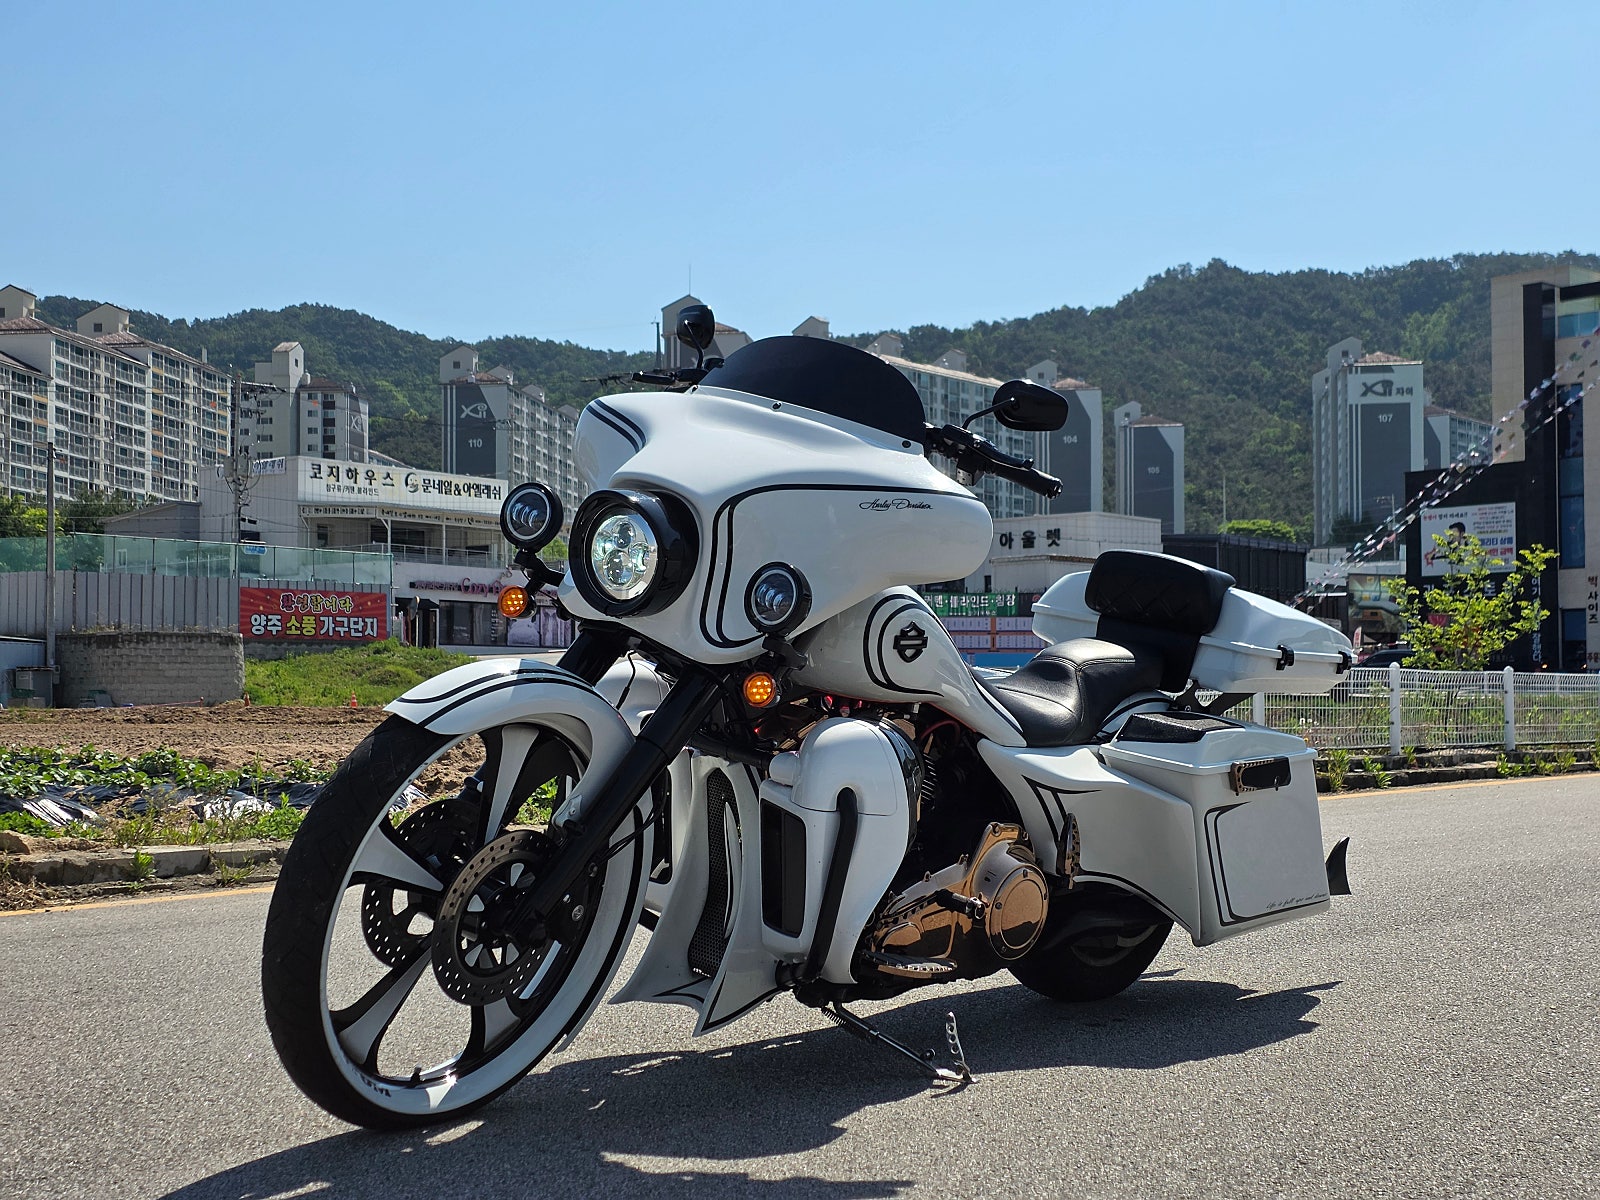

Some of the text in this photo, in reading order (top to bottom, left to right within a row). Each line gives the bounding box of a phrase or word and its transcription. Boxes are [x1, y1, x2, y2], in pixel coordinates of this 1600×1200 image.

[1396, 386, 1413, 396] 자이
[1378, 413, 1393, 423] 107
[468, 438, 483, 448] 110
[1063, 435, 1078, 444] 104
[310, 463, 395, 487] 코지하우스
[1000, 528, 1061, 549] 아울렛
[461, 577, 489, 597] Cozy
[281, 593, 353, 613] 환영합니다
[250, 614, 378, 637] 양주 소풍 가구단지
